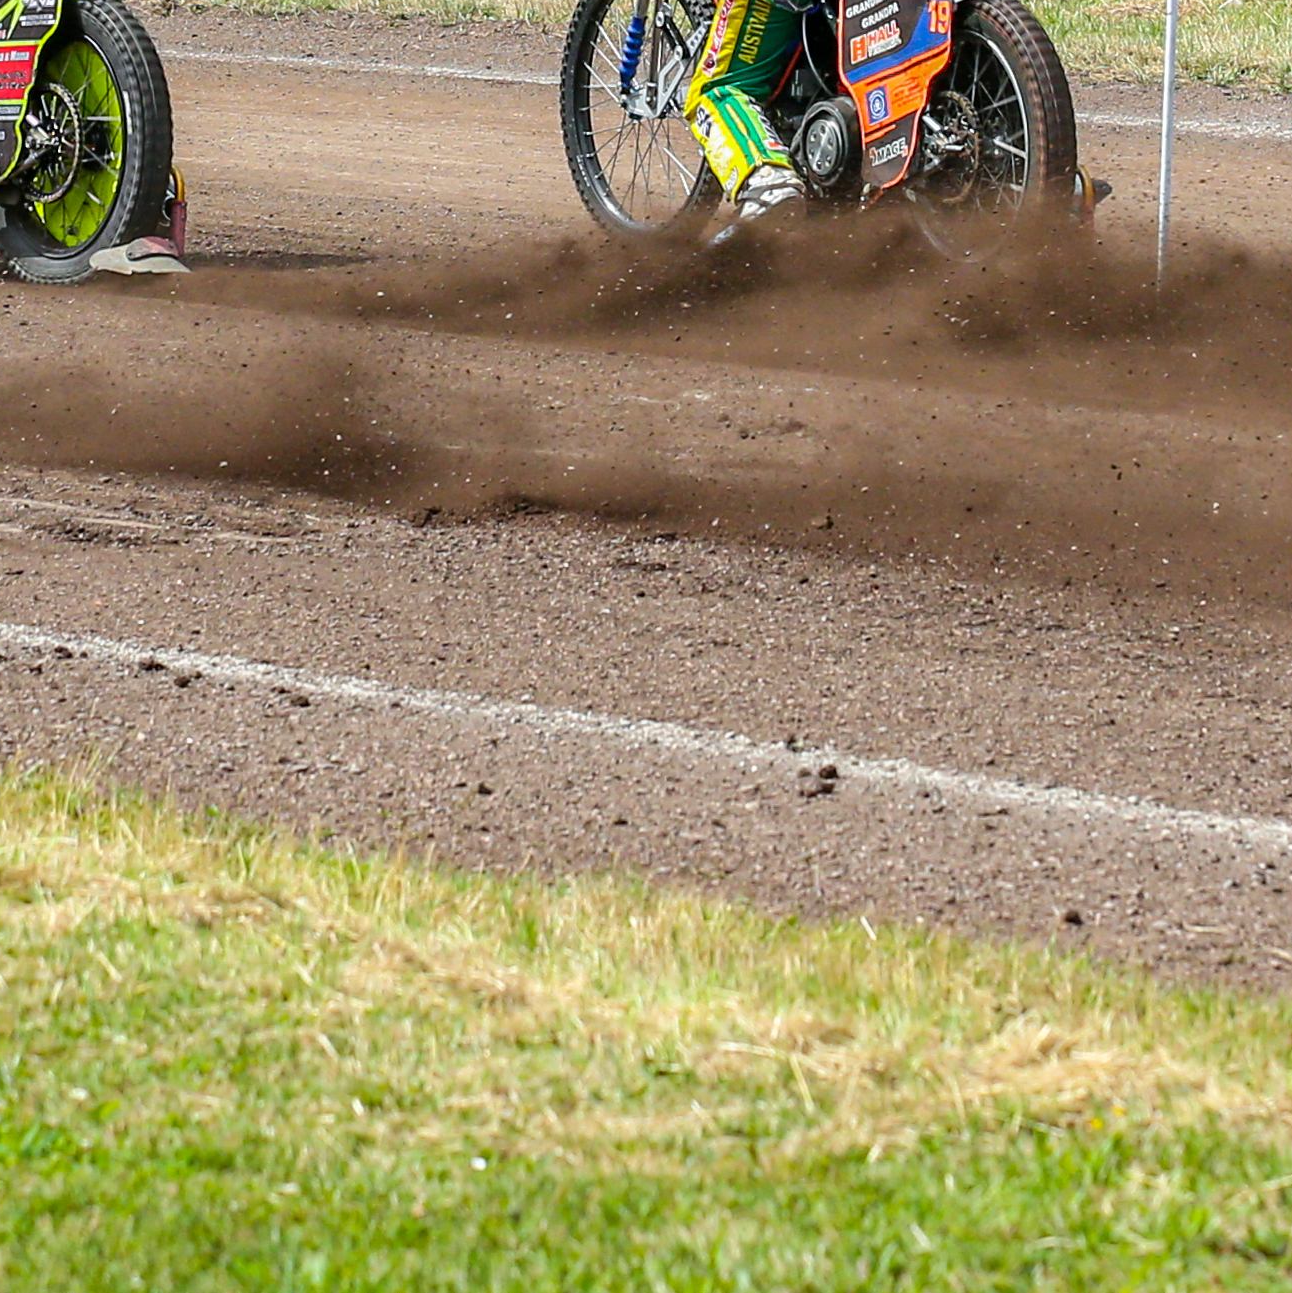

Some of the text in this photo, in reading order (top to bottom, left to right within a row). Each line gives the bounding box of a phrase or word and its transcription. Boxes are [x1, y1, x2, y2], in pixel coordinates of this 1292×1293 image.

[861, 1, 900, 29] GRANDPA
[927, 0, 950, 34] 19
[867, 19, 901, 46] HALL
